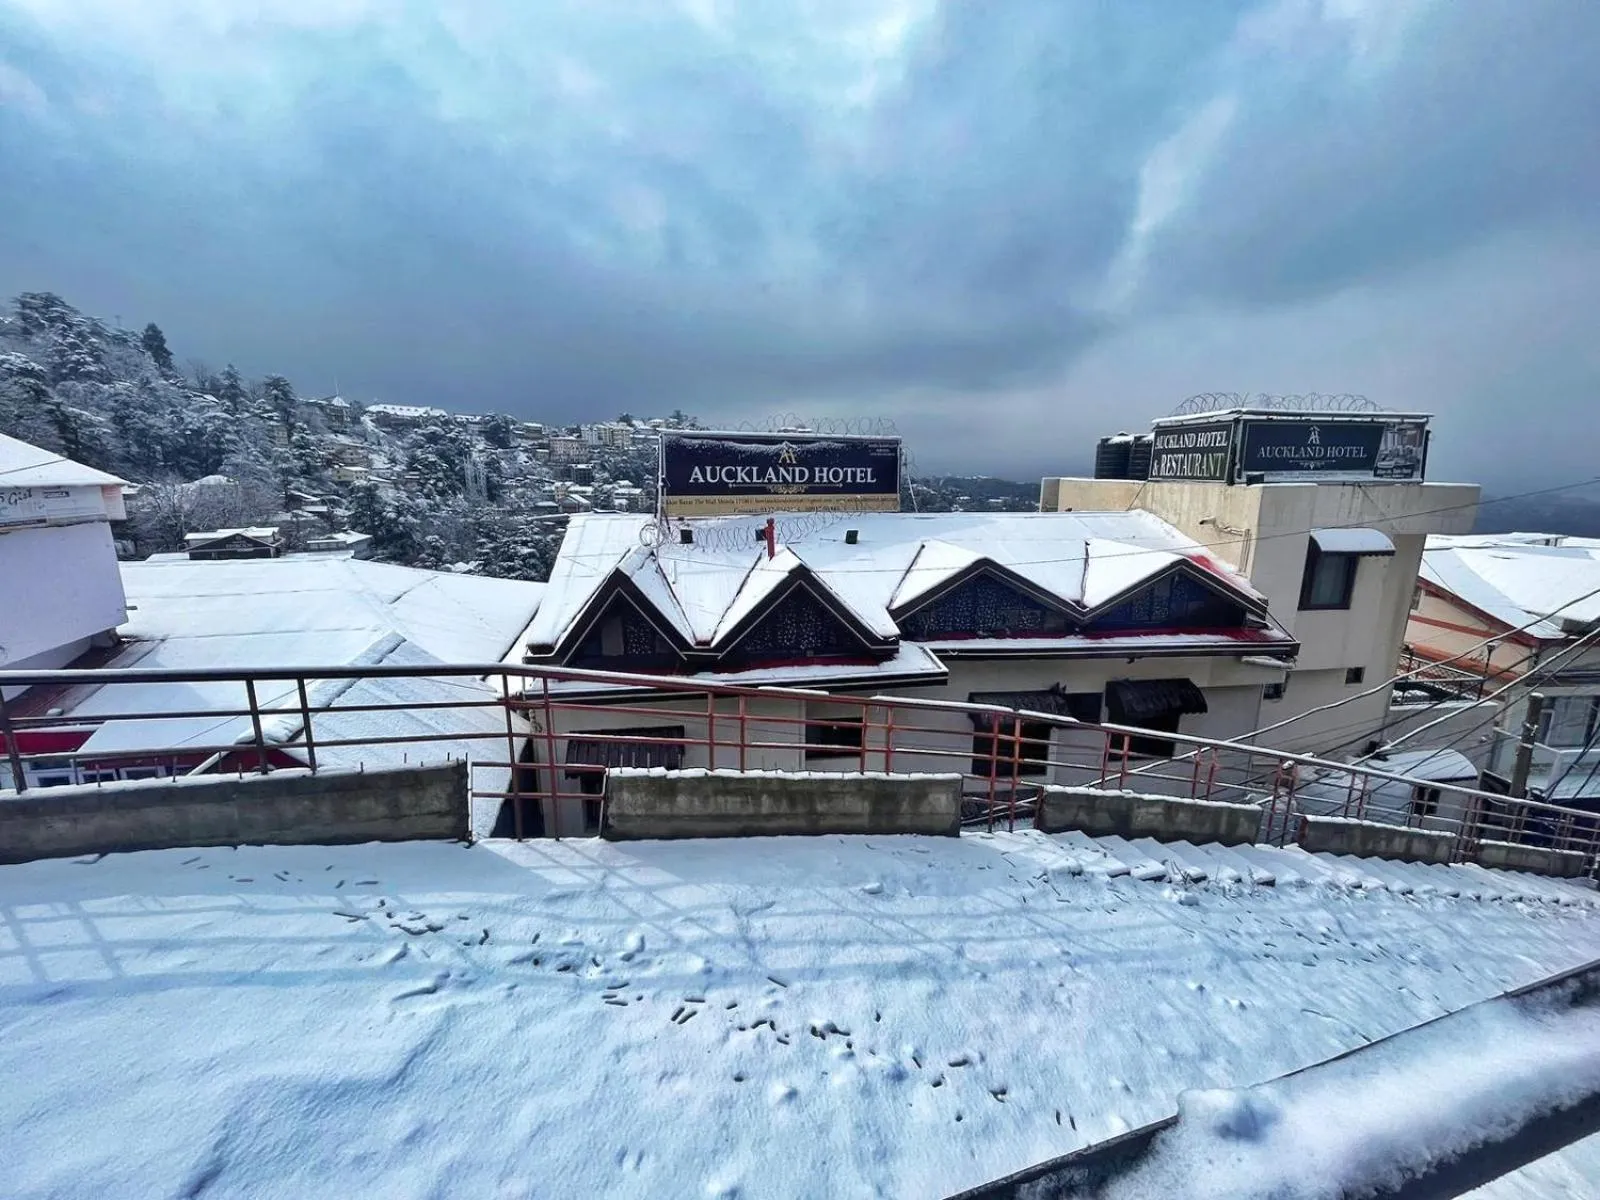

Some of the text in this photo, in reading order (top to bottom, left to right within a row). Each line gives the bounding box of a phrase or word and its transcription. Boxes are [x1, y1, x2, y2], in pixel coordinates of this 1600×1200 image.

[1155, 431, 1228, 449] AUCKLAND HOTEL
[1257, 446, 1368, 459] AUCKLAND HOTEL
[1152, 452, 1225, 477] & RESTAURANT
[689, 466, 877, 483] AUCKLAND HOTEL
